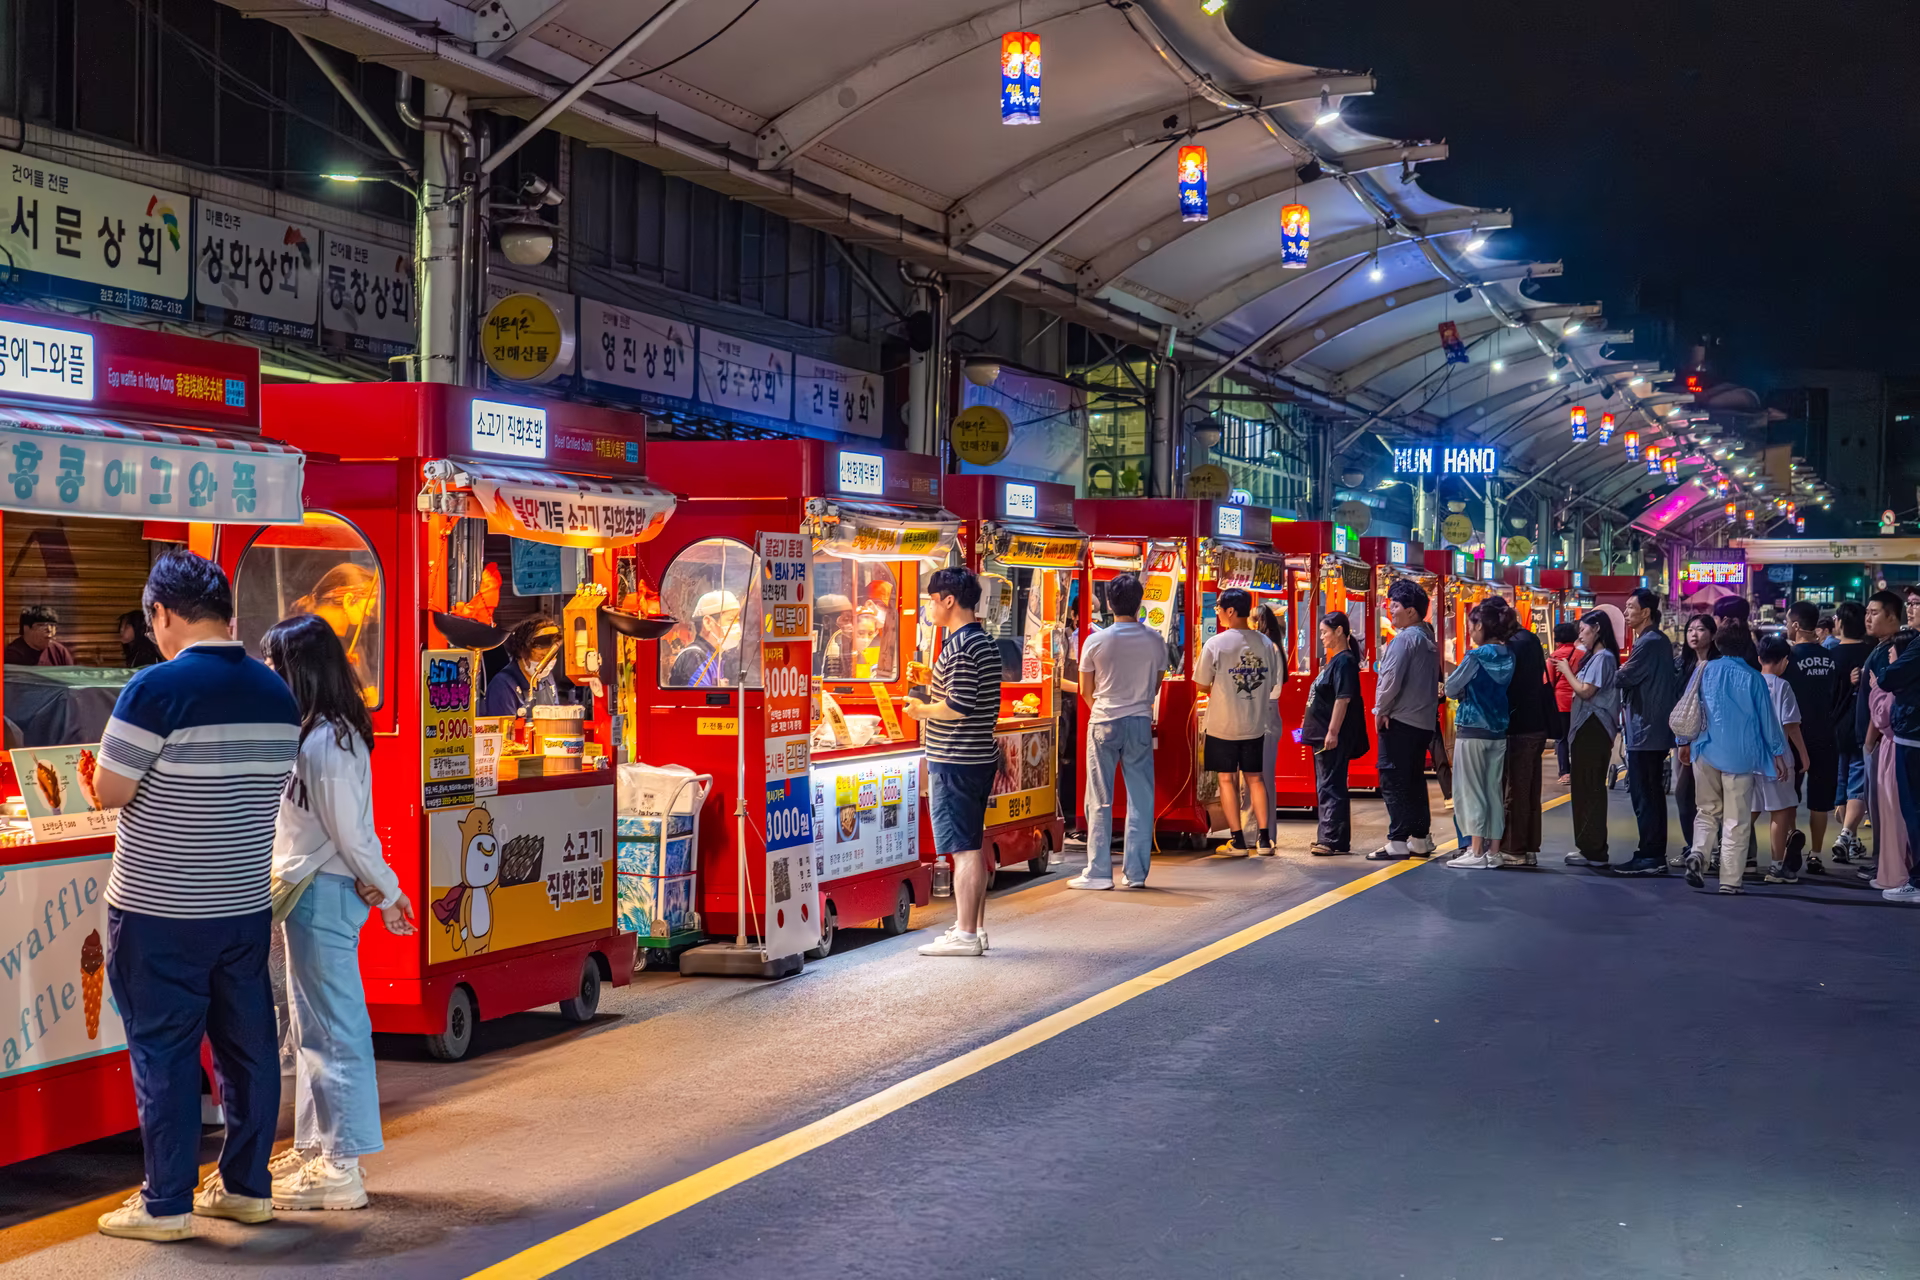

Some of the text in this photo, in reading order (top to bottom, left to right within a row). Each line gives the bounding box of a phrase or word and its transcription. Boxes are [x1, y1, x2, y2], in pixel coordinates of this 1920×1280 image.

[12, 164, 69, 194] 건어물 전문
[11, 196, 162, 275] 서문상회
[202, 236, 299, 299] 성화상회
[330, 241, 369, 265] 건어물 전문
[100, 289, 113, 302] 점포
[493, 346, 550, 363] 건해산물
[602, 332, 676, 382] 영진상회
[108, 367, 174, 394] Egg waffle in Hong Kong
[717, 359, 776, 404] 강수상회
[477, 412, 543, 449] 소고기 직화초밥
[554, 434, 593, 452] Beef Grilled Sushi
[1394, 448, 1432, 473] MUN
[8, 440, 258, 513] 홍콩에그와플
[512, 496, 646, 537] 불맛가득 소고기 직화초밥
[766, 538, 803, 558] 불경기 동행
[774, 562, 806, 581] 행사 가격
[775, 607, 807, 635] 떡볶이
[430, 658, 457, 683] 소고기
[1797, 657, 1836, 671] KOREA
[766, 742, 807, 774] 도시락 김밥
[766, 806, 810, 842] 3000원
[562, 829, 603, 863] 소고기
[547, 866, 605, 909] 직화초밥
[0, 876, 99, 981] waffle
